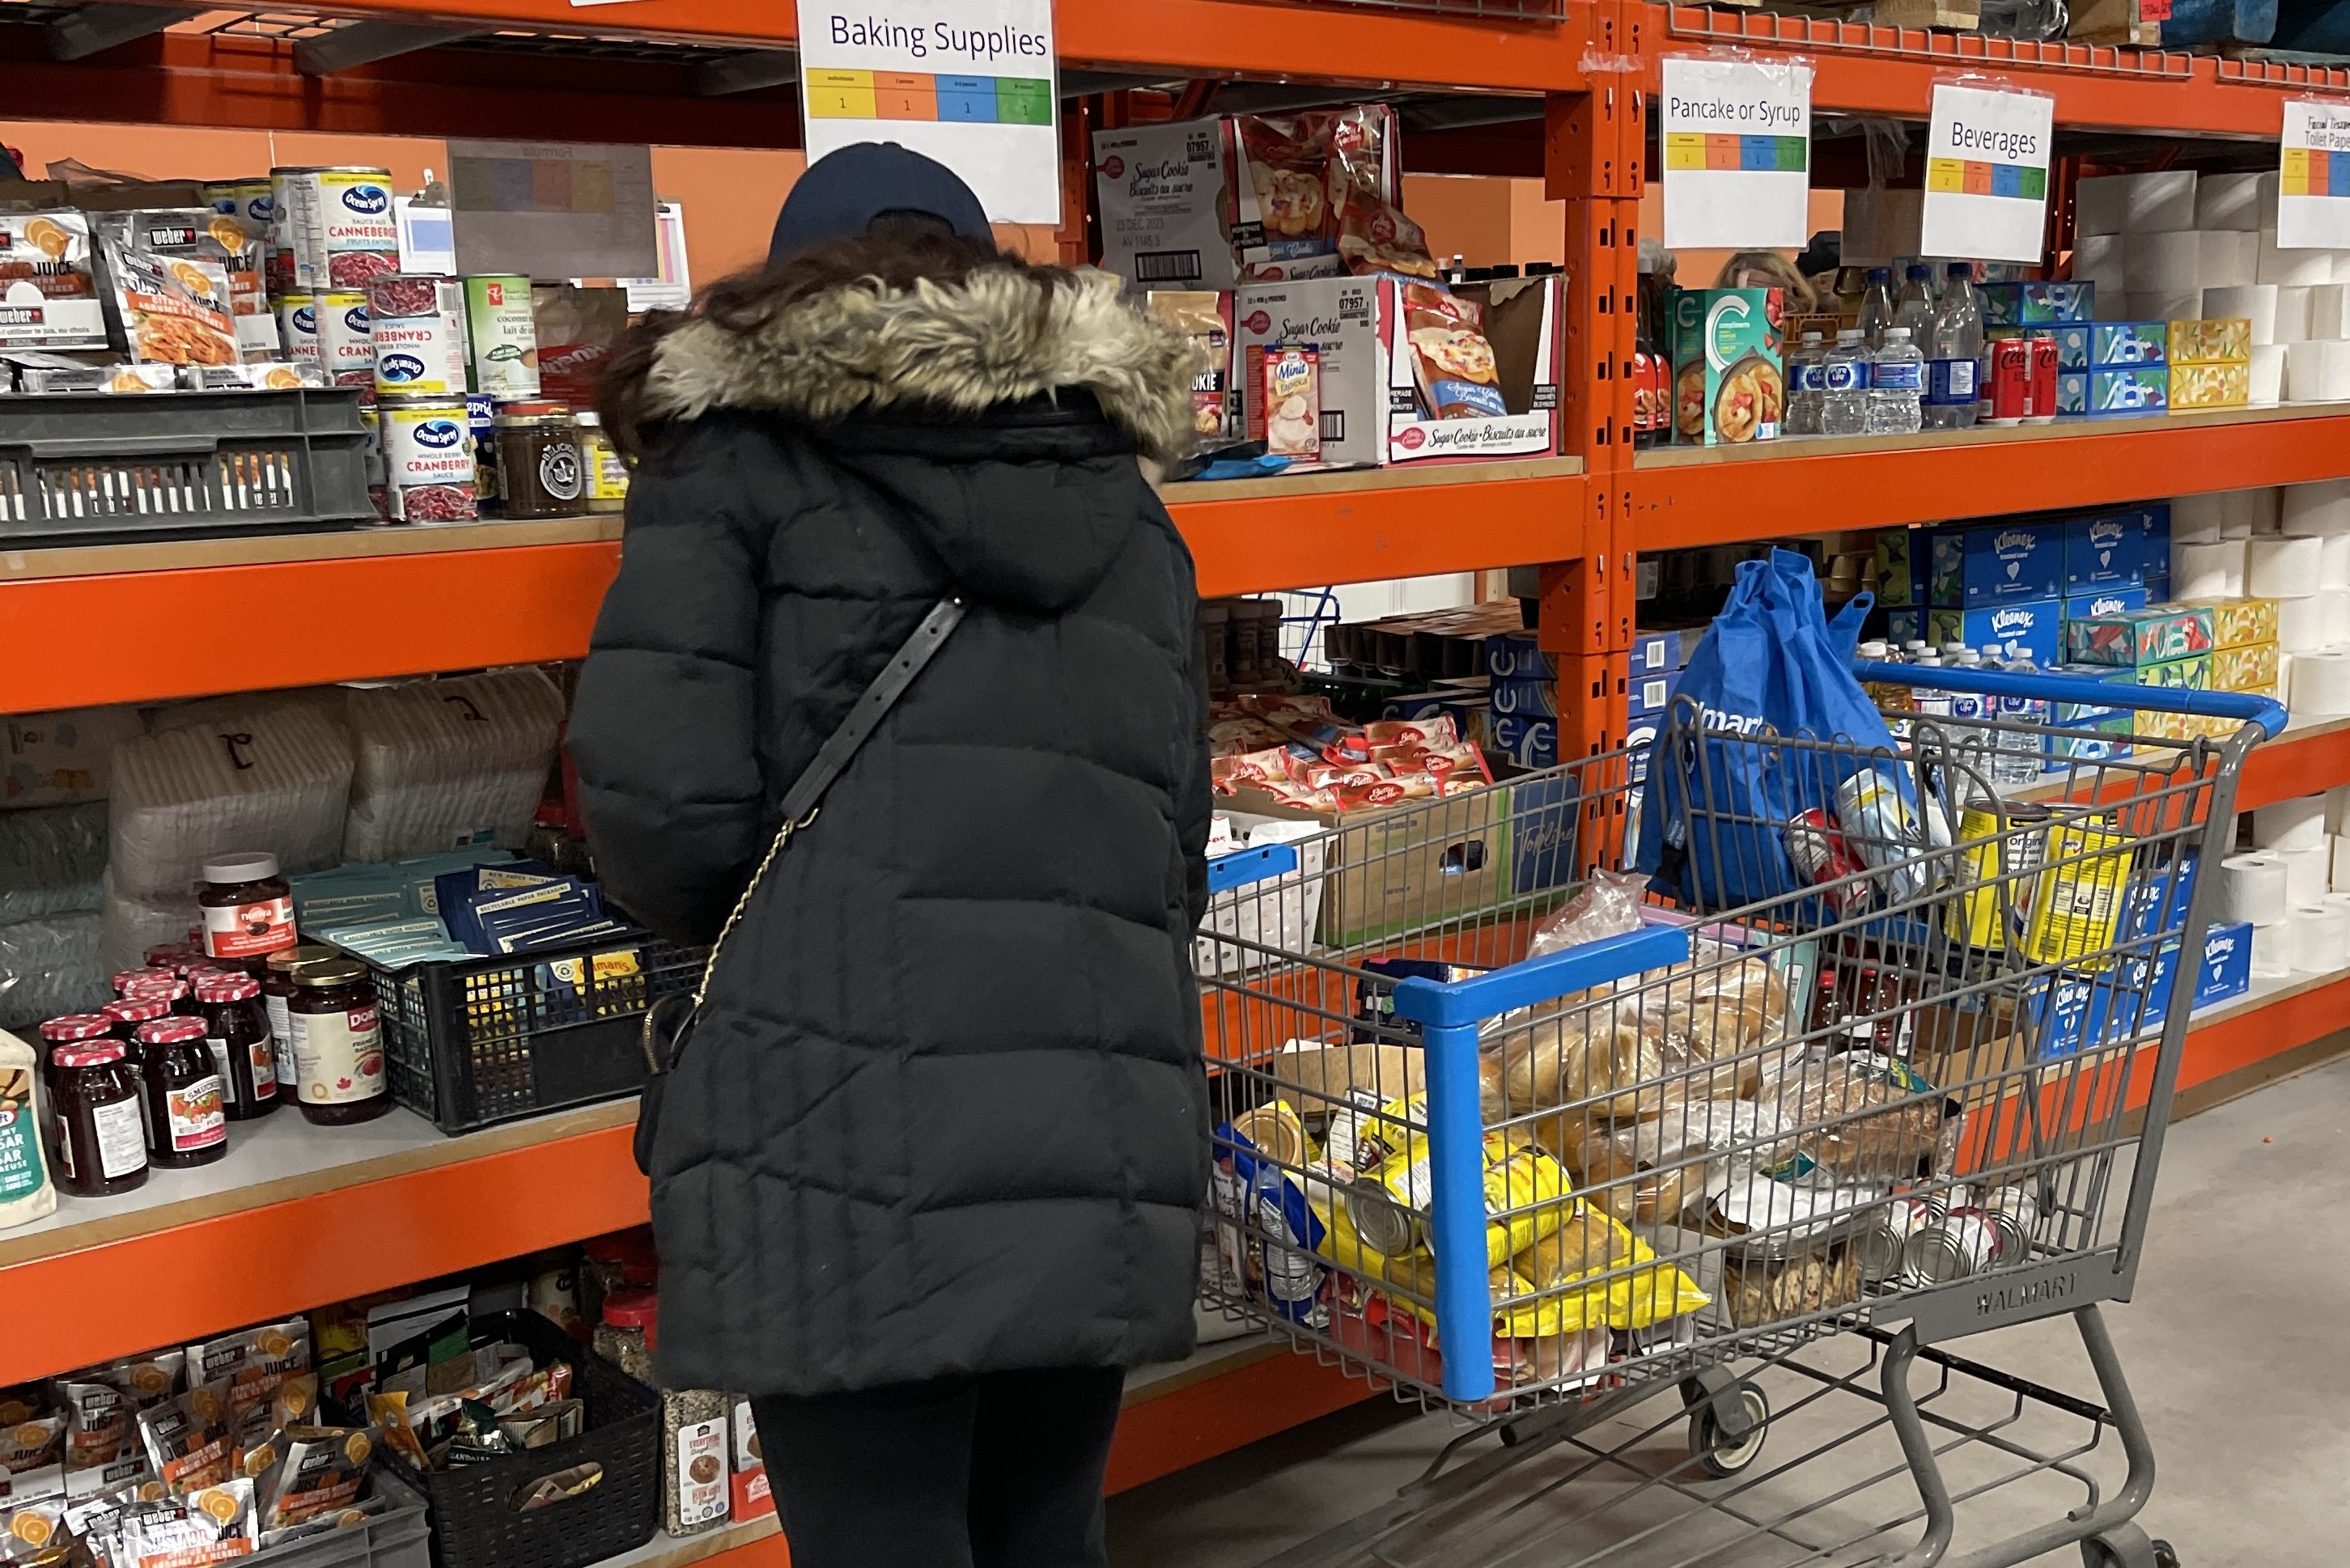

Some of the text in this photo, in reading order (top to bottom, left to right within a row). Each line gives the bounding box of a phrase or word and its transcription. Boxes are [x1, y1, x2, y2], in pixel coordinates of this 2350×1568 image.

[831, 15, 1046, 61] Baking Supplies
[904, 100, 910, 111] 1
[965, 103, 971, 114] 1
[1671, 97, 1801, 127] Pancake or Syrup
[1952, 121, 2036, 159] Beverages
[1133, 161, 1190, 182] Sugar Cookie
[346, 193, 384, 210] Ocean Spray
[1127, 218, 1144, 231] DEC
[153, 227, 185, 244] weber
[32, 261, 73, 277] JUICE
[1339, 297, 1364, 310] 07957
[0, 307, 32, 324] weber
[1279, 316, 1341, 340] Sugar Cookie
[400, 359, 422, 373] Ocean
[1279, 361, 1307, 379] Minit
[1280, 377, 1308, 393] Tapioca
[417, 429, 457, 444] Ocean Spray
[1428, 429, 1454, 448] Sugar
[1454, 429, 1478, 445] Cookie
[1483, 424, 1514, 441] Biscuits
[1525, 426, 1546, 439] sucre
[407, 460, 469, 472] CRANBERRY
[1994, 531, 2036, 554] Kleenex
[2091, 597, 2125, 616] Kleenex
[1992, 608, 2034, 633] Kleenex
[1369, 790, 1400, 803] Crocker
[1372, 786, 1394, 797] Betty
[2055, 985, 2089, 1011] Kleeex
[1977, 1271, 2077, 1316] WALMART
[206, 1350, 235, 1371] weber
[262, 1356, 297, 1376] JUICE
[85, 1392, 118, 1409] weber
[143, 1510, 176, 1525] weber
